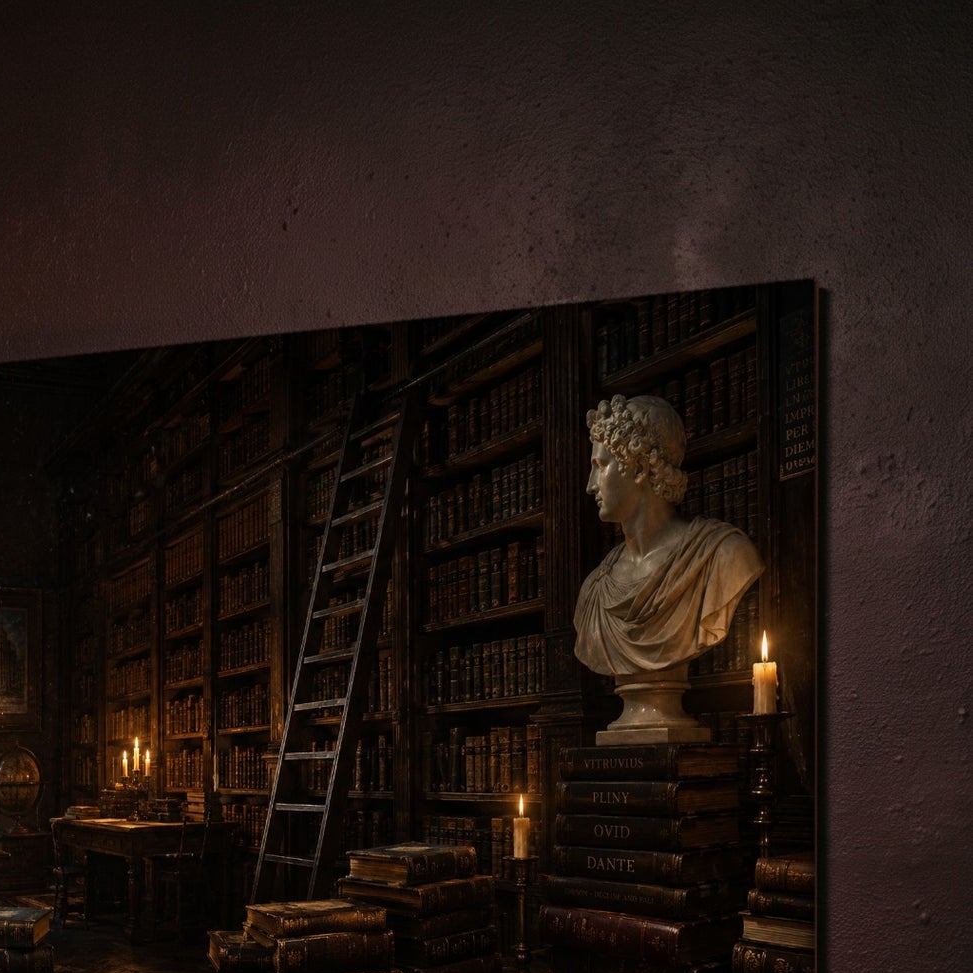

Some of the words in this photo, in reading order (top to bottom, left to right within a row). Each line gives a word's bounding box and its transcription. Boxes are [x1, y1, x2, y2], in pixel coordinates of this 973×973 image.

[786, 424, 809, 440] PER
[583, 758, 644, 769] VITRUVIUS
[592, 791, 630, 804] PLINY
[594, 824, 631, 838] OVID
[587, 855, 635, 873] DANTE
